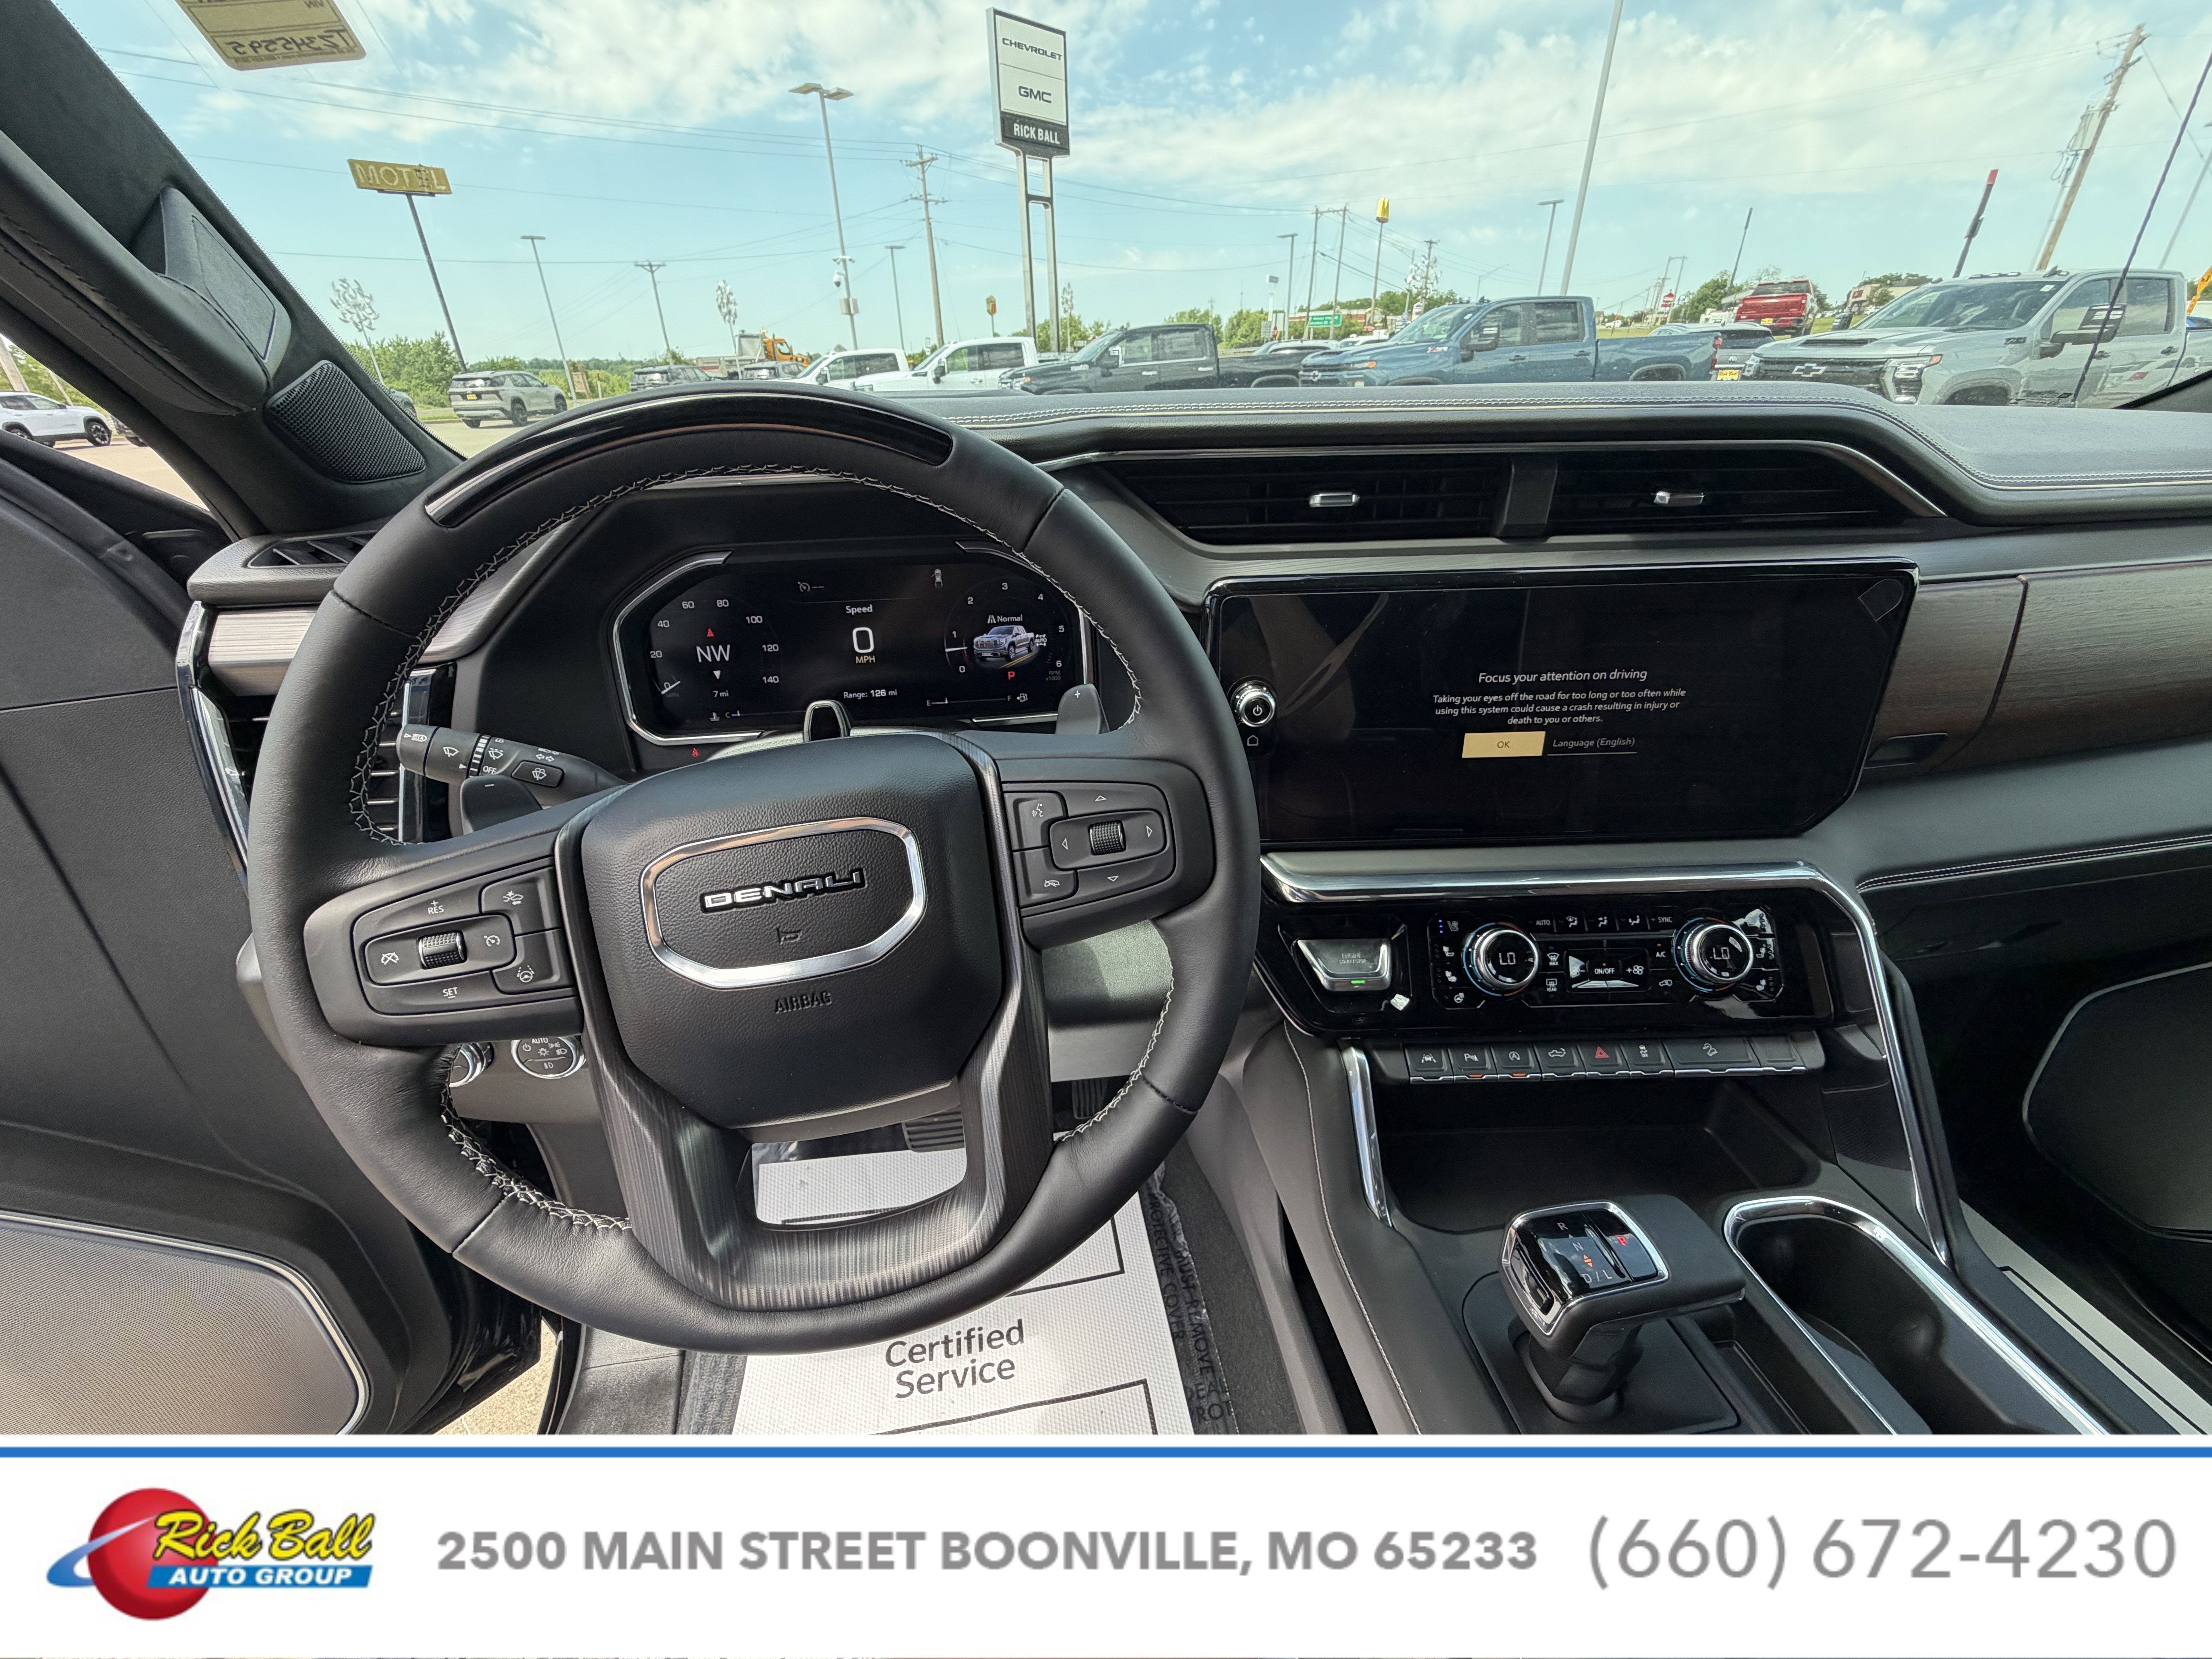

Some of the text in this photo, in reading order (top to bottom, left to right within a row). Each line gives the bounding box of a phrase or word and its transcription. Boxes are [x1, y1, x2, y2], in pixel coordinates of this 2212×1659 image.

[1002, 38, 1062, 60] CHEVROLET
[1018, 86, 1052, 103] GMC
[1013, 123, 1060, 144] RICK BALL
[845, 604, 873, 615] Speed
[745, 616, 763, 624] 100
[997, 614, 1023, 622] Normal
[852, 627, 874, 653] 0
[696, 644, 730, 663] NW
[762, 644, 779, 652] 120
[855, 655, 876, 664] MPH
[1008, 671, 1015, 680] P
[1479, 668, 1647, 685] Focus your attention on driving
[843, 692, 868, 700] Range:
[870, 689, 886, 697] 126
[1433, 694, 1461, 704] Taking
[1462, 696, 1482, 704] your
[1483, 695, 1503, 703] eyes
[1504, 692, 1520, 701] off
[1535, 692, 1556, 700] road
[1557, 691, 1570, 699] for
[1588, 690, 1607, 701] long
[1638, 689, 1661, 697] often
[1663, 688, 1686, 697] while
[1435, 707, 1459, 716] using
[1461, 706, 1477, 714] this
[1478, 706, 1509, 715] system
[1510, 704, 1535, 713] could
[1569, 702, 1593, 711] crash
[1594, 702, 1632, 711] resulting
[1644, 701, 1668, 711] injury
[1507, 716, 1532, 724] death
[1543, 716, 1560, 725] you
[1573, 714, 1603, 723] others.
[1553, 739, 1595, 749] Language
[1596, 737, 1635, 748] (English)
[483, 766, 497, 774] OFF
[703, 871, 861, 909] DENALI
[428, 905, 444, 914] RES
[1499, 952, 1516, 965] LO
[1713, 946, 1730, 960] LO
[443, 987, 458, 996] SET
[775, 991, 832, 1013] AIRBAG
[1557, 1222, 1569, 1231] R
[1572, 1242, 1584, 1251] N
[1616, 1235, 1626, 1246] P
[1164, 1283, 1186, 1339] COVER
[885, 1319, 1025, 1367] Certified
[1186, 1300, 1216, 1373] REMOVE
[895, 1358, 1016, 1399] Service
